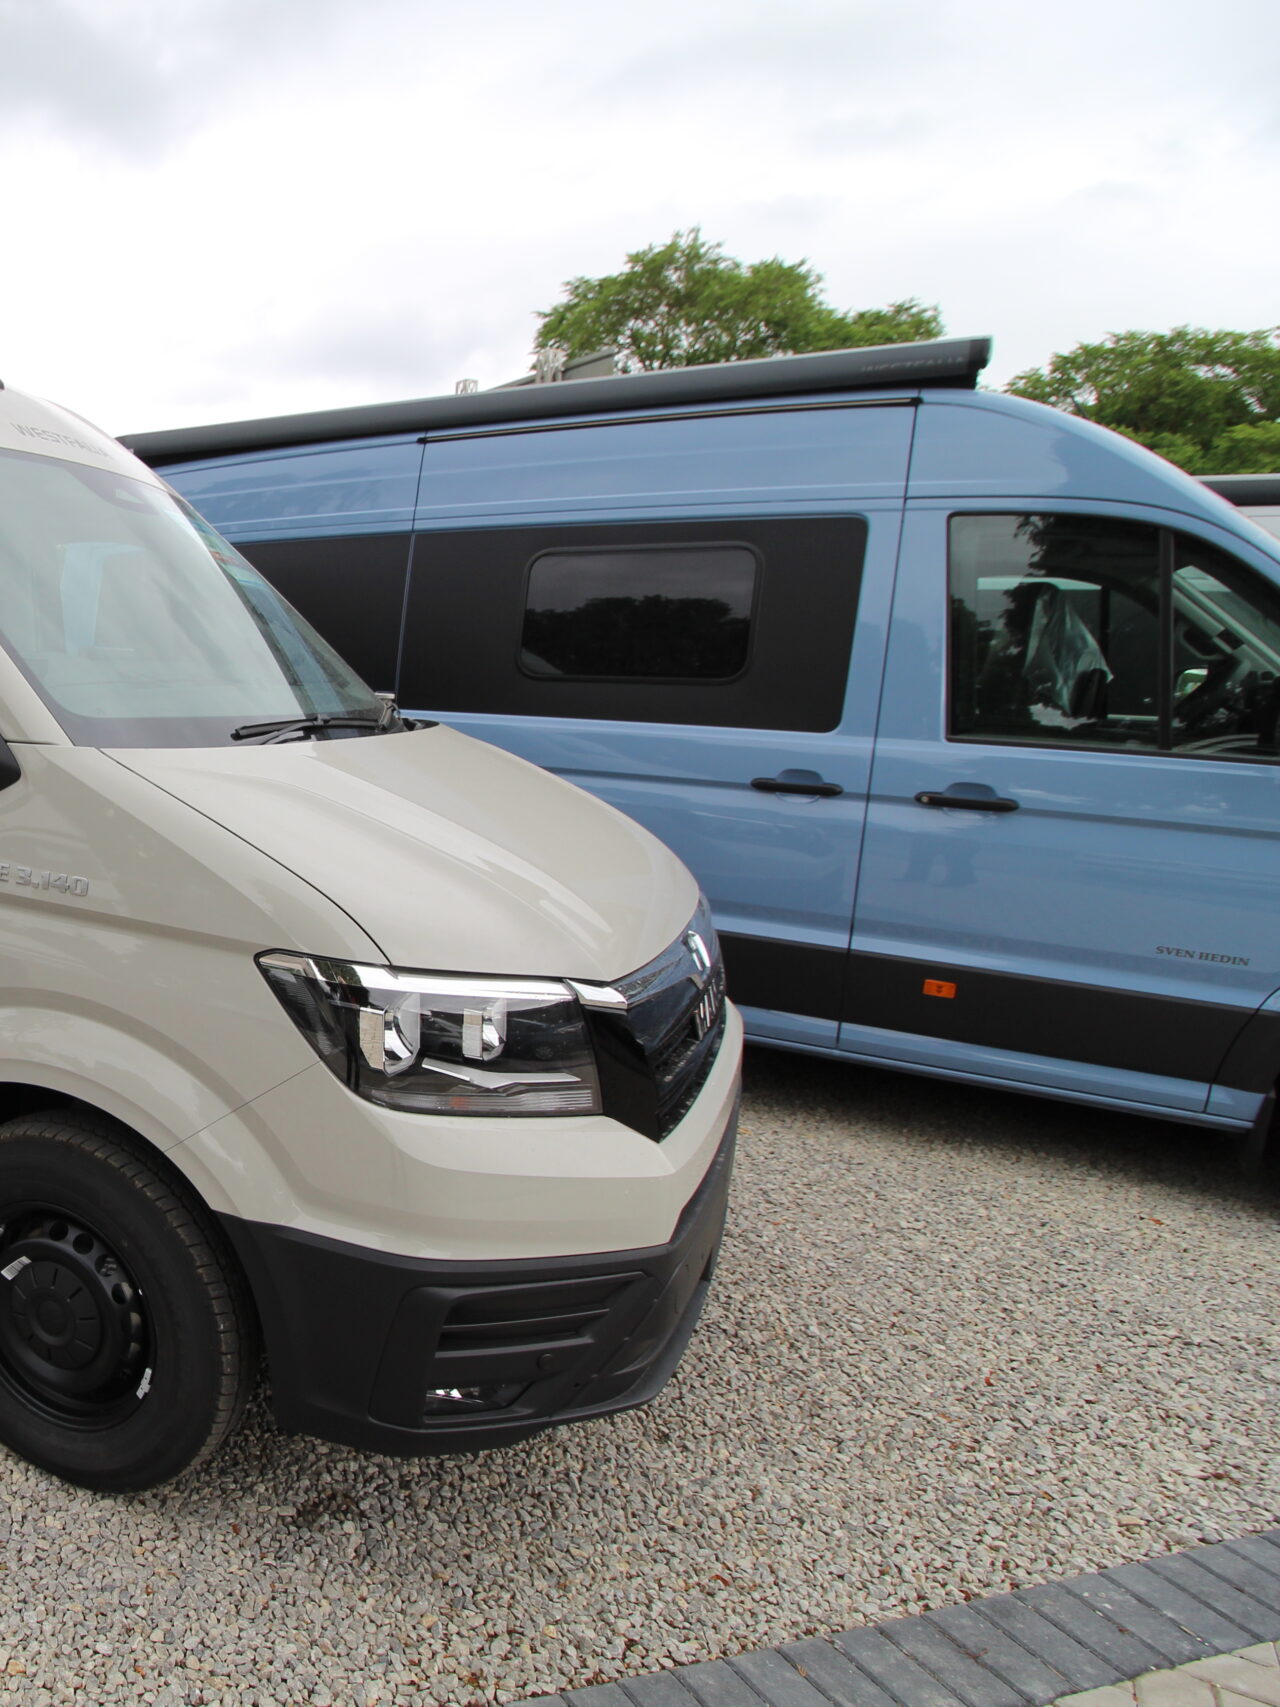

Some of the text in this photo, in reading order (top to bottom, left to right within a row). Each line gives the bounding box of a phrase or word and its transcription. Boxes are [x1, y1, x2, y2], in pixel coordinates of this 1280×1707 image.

[15, 866, 89, 896] 3.140
[1155, 945, 1251, 966] SVEN HEDIN
